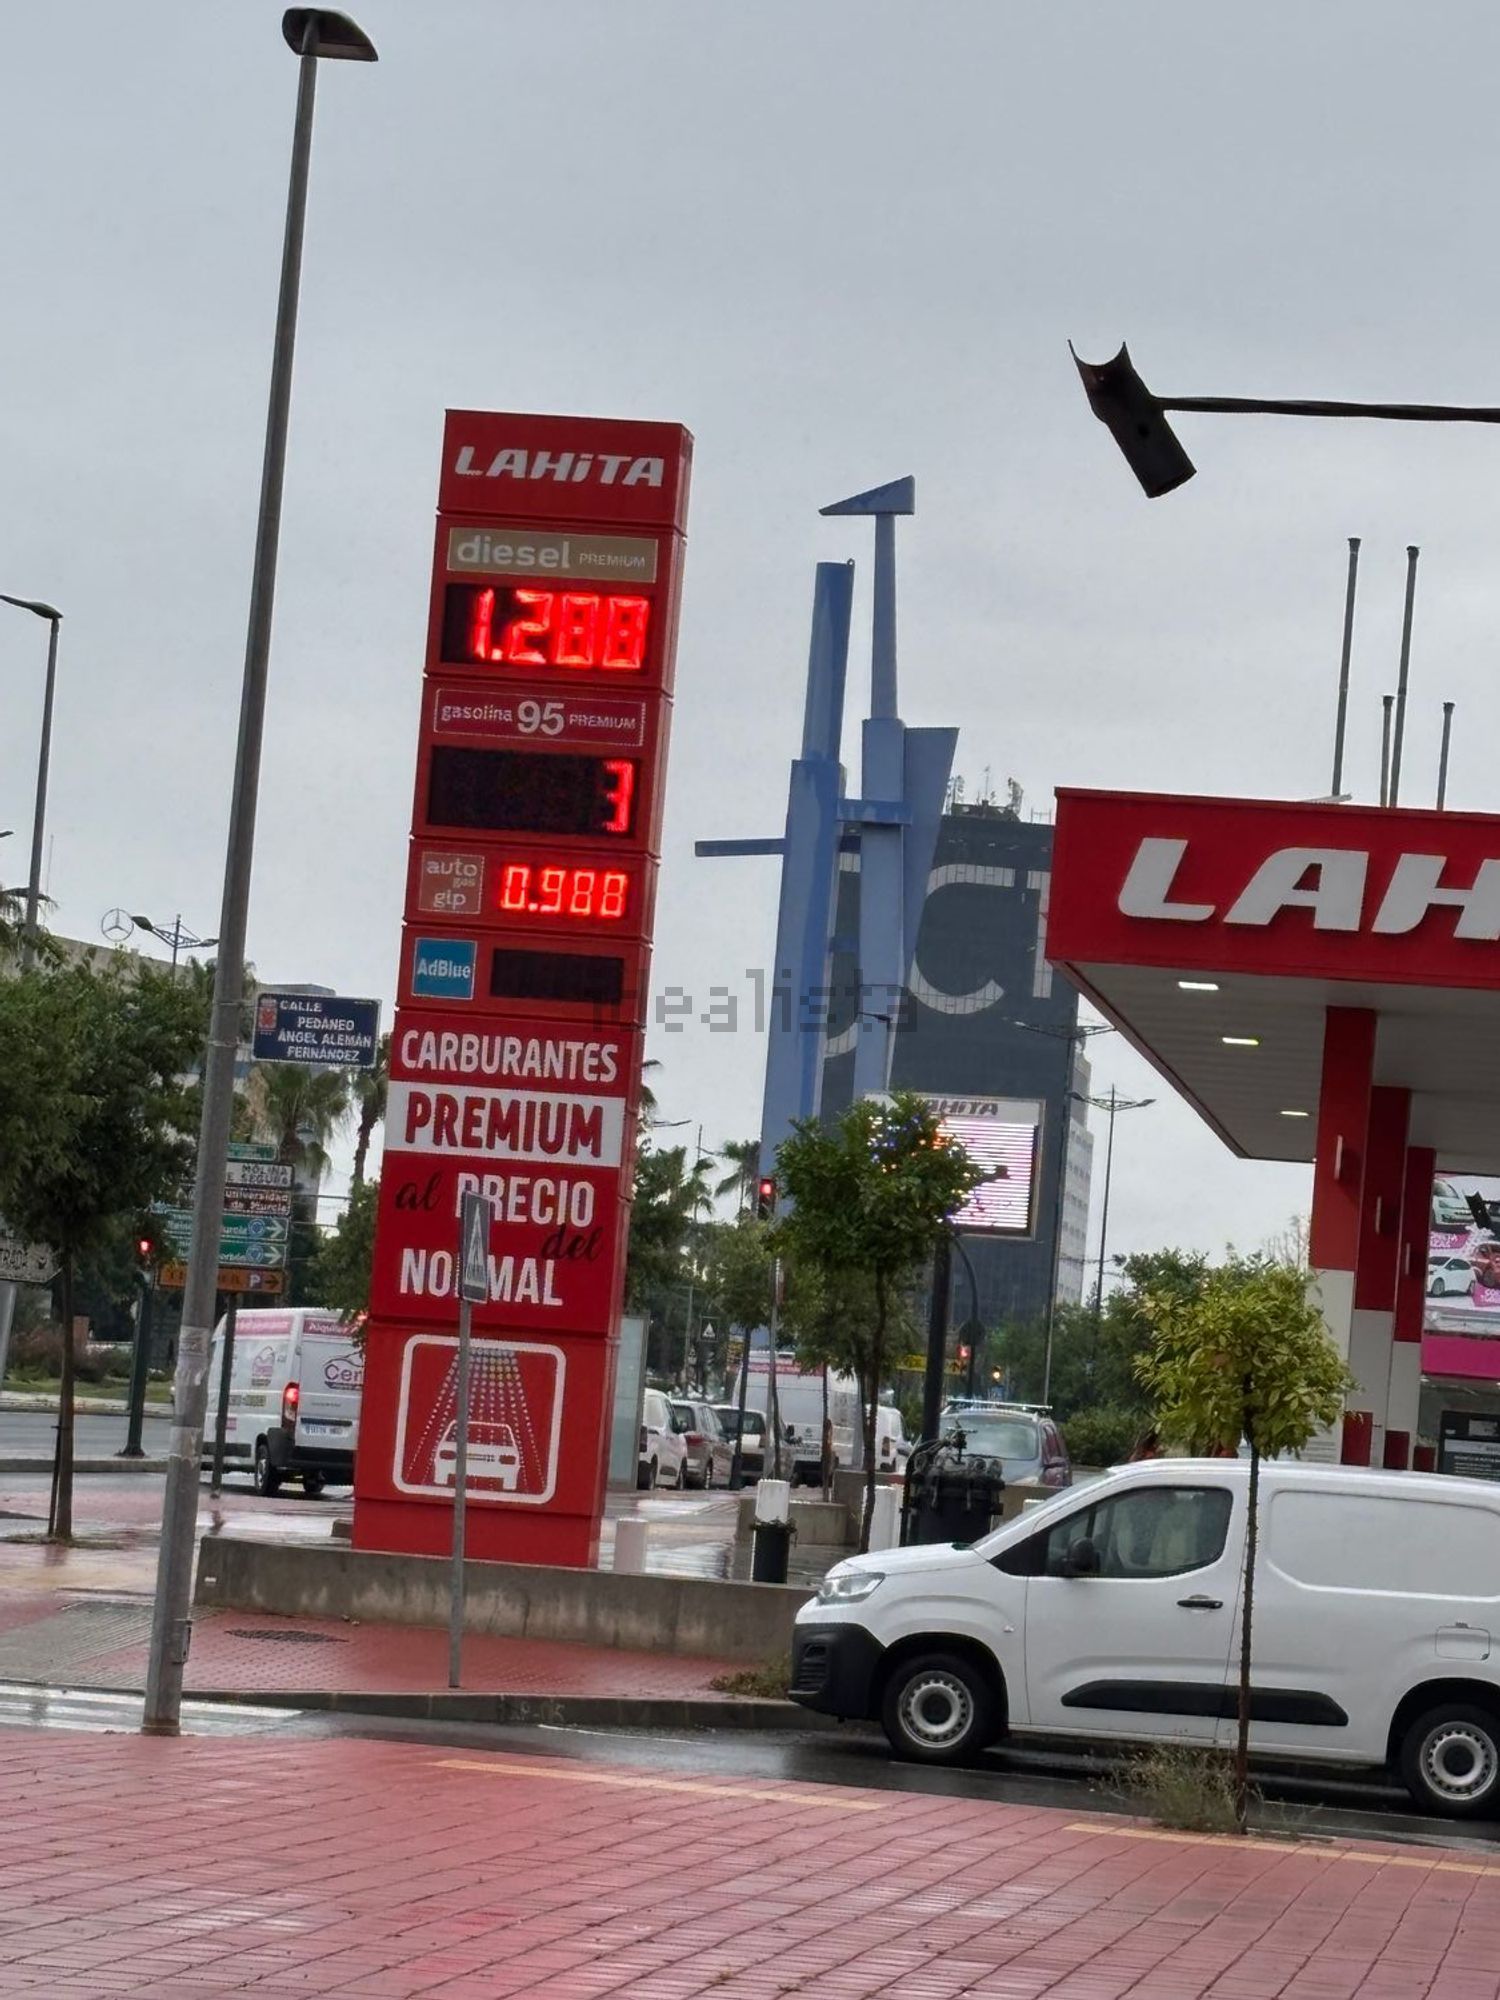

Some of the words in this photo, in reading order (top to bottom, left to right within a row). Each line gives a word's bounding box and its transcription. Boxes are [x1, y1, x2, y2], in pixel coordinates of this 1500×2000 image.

[457, 535, 570, 569] diesel
[579, 553, 645, 567] PREMIUM
[441, 702, 512, 722] gasolina
[517, 700, 565, 735] 95
[569, 714, 636, 730] PREMIUM
[426, 857, 478, 878] auto
[501, 866, 628, 917] 0.988
[416, 956, 472, 979] AdBlue
[280, 1000, 322, 1013] CALLE
[278, 1028, 318, 1045] ÁNGEL
[401, 1030, 618, 1082] CARBURANTES
[405, 1091, 604, 1158] PREMIUM
[395, 1171, 442, 1211] al
[455, 1172, 595, 1228] PRECIO
[540, 1224, 603, 1261] del
